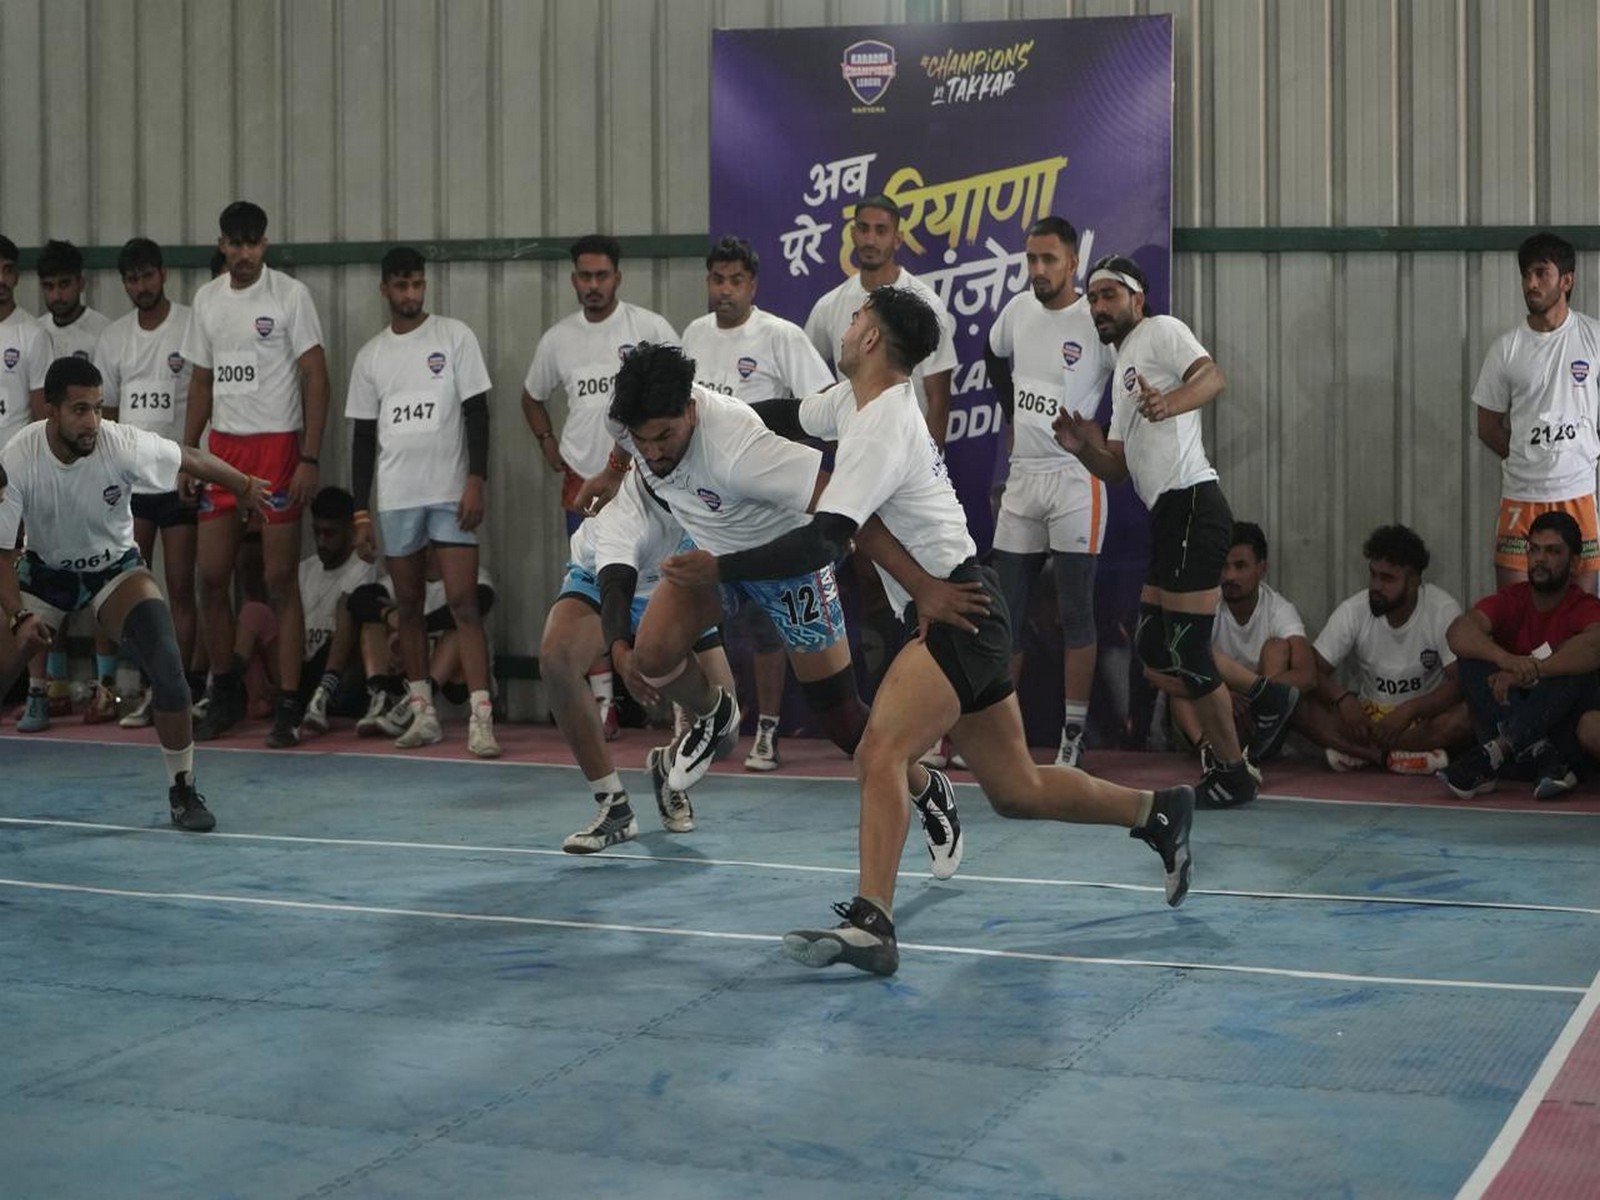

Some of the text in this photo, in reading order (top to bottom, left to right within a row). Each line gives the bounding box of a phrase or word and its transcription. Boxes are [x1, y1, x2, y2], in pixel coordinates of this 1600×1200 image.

[947, 71, 1016, 103] TAKKAR
[803, 153, 877, 207] अब
[780, 214, 832, 277] पूरे
[217, 365, 255, 382] 2009
[950, 359, 994, 396] KA
[130, 392, 171, 410] 2133
[393, 402, 435, 424] 2147
[1018, 390, 1058, 417] 2063
[945, 401, 1003, 443] DDI
[1508, 507, 1522, 530] 7
[60, 548, 111, 570] 2061
[780, 584, 820, 626] 12
[1376, 677, 1421, 695] 2028
